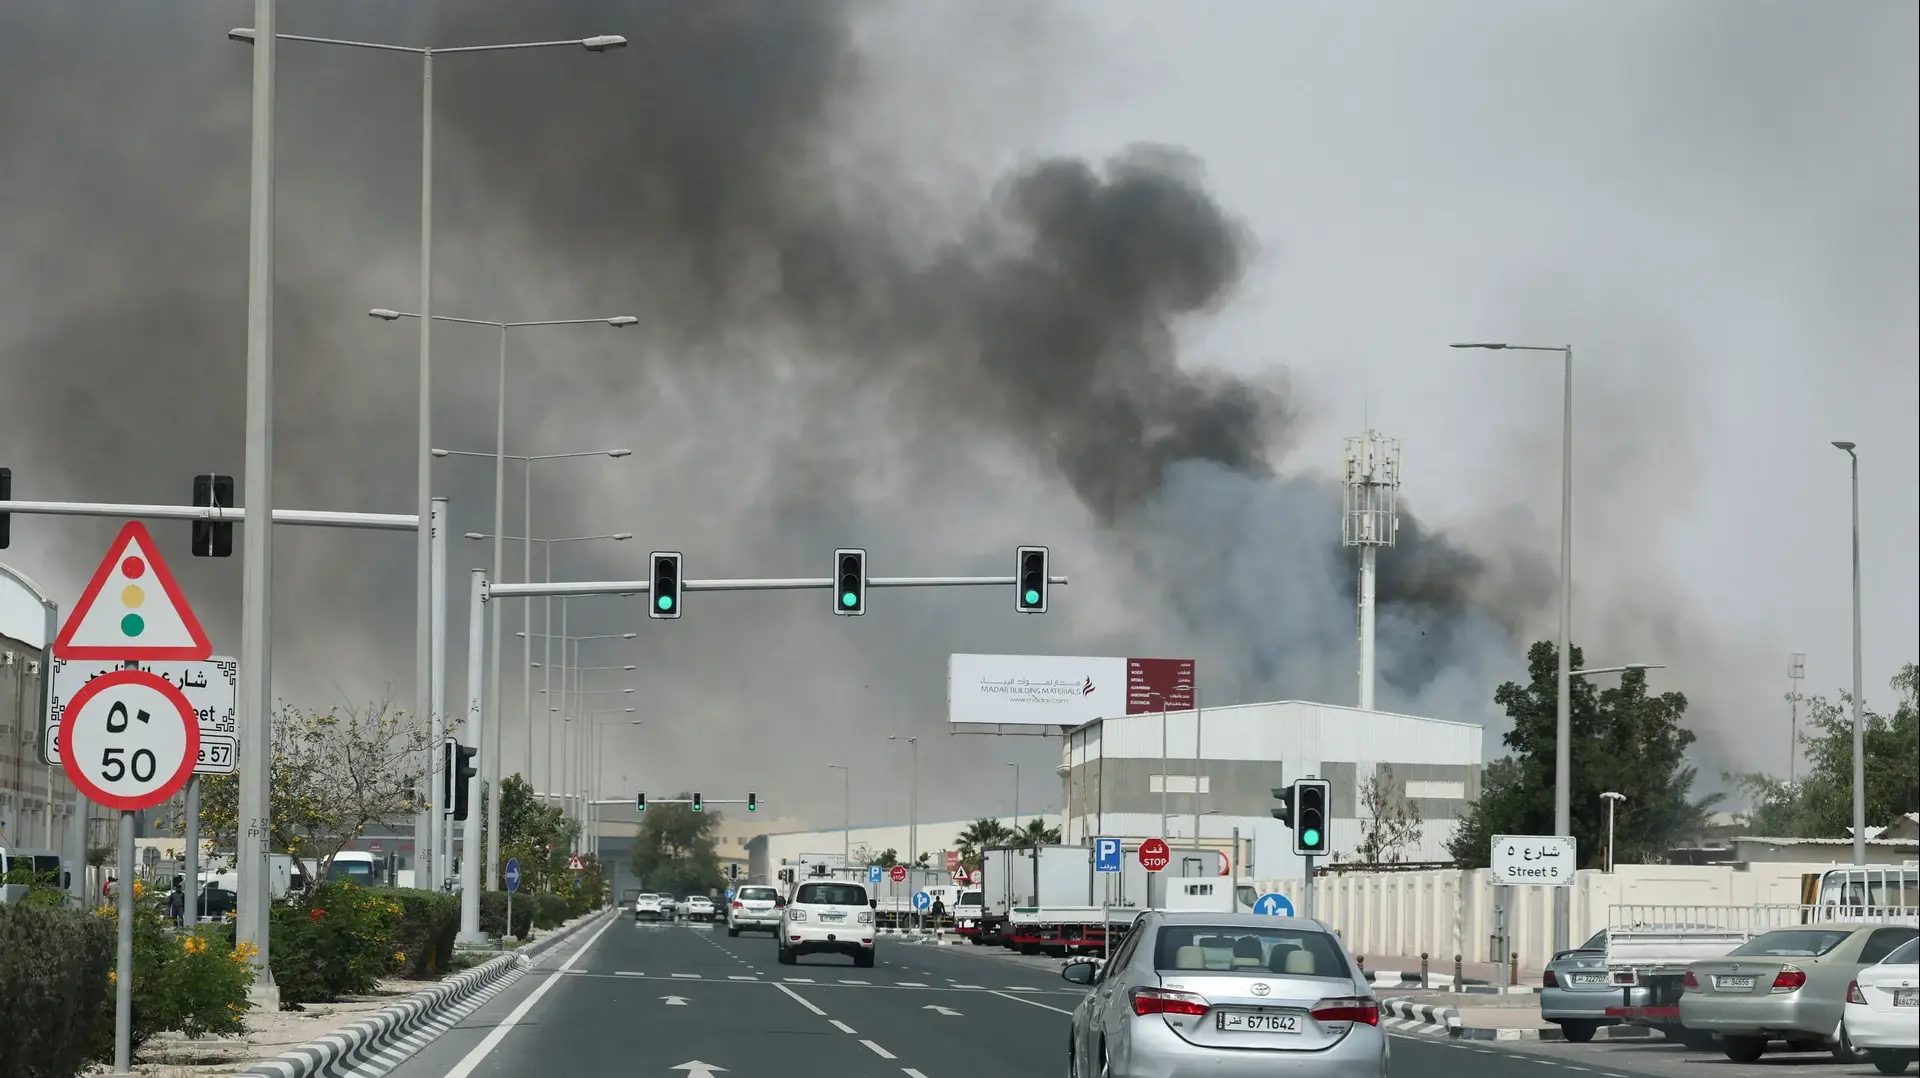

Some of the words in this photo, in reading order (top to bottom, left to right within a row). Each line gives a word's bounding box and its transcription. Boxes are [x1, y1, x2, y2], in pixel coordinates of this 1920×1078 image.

[106, 701, 150, 733] ٥٠
[211, 746, 229, 763] 57
[101, 748, 156, 783] 50
[251, 819, 257, 828] Z
[247, 829, 260, 838] FP
[1100, 840, 1116, 861] P
[1145, 844, 1163, 854] قف
[1507, 846, 1515, 856] ٥
[1524, 846, 1560, 861] شارع
[1143, 858, 1167, 866] STOP
[871, 866, 879, 878] P
[1508, 866, 1547, 877] Street
[1550, 866, 1558, 877] 5
[1225, 1016, 1242, 1026] قطر
[1248, 1016, 1296, 1031] 671642
